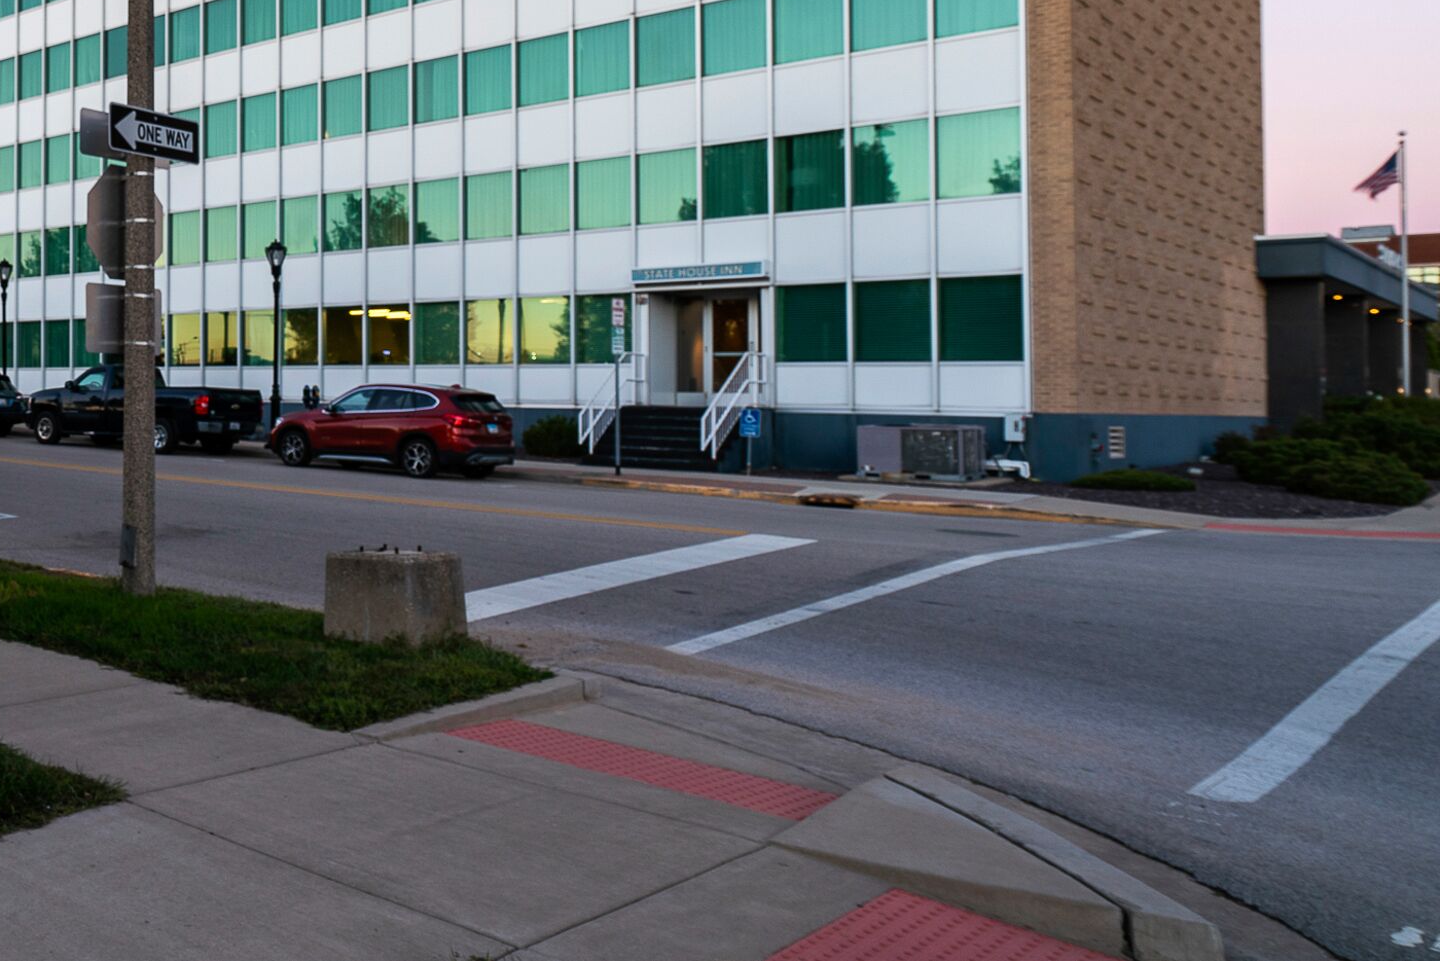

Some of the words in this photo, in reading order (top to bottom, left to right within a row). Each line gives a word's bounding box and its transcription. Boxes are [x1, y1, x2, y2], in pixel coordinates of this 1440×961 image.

[137, 123, 163, 144] ONE
[166, 129, 191, 149] WAY
[644, 268, 674, 279] STATE
[678, 265, 717, 277] HOUSE
[720, 264, 743, 275] INN
